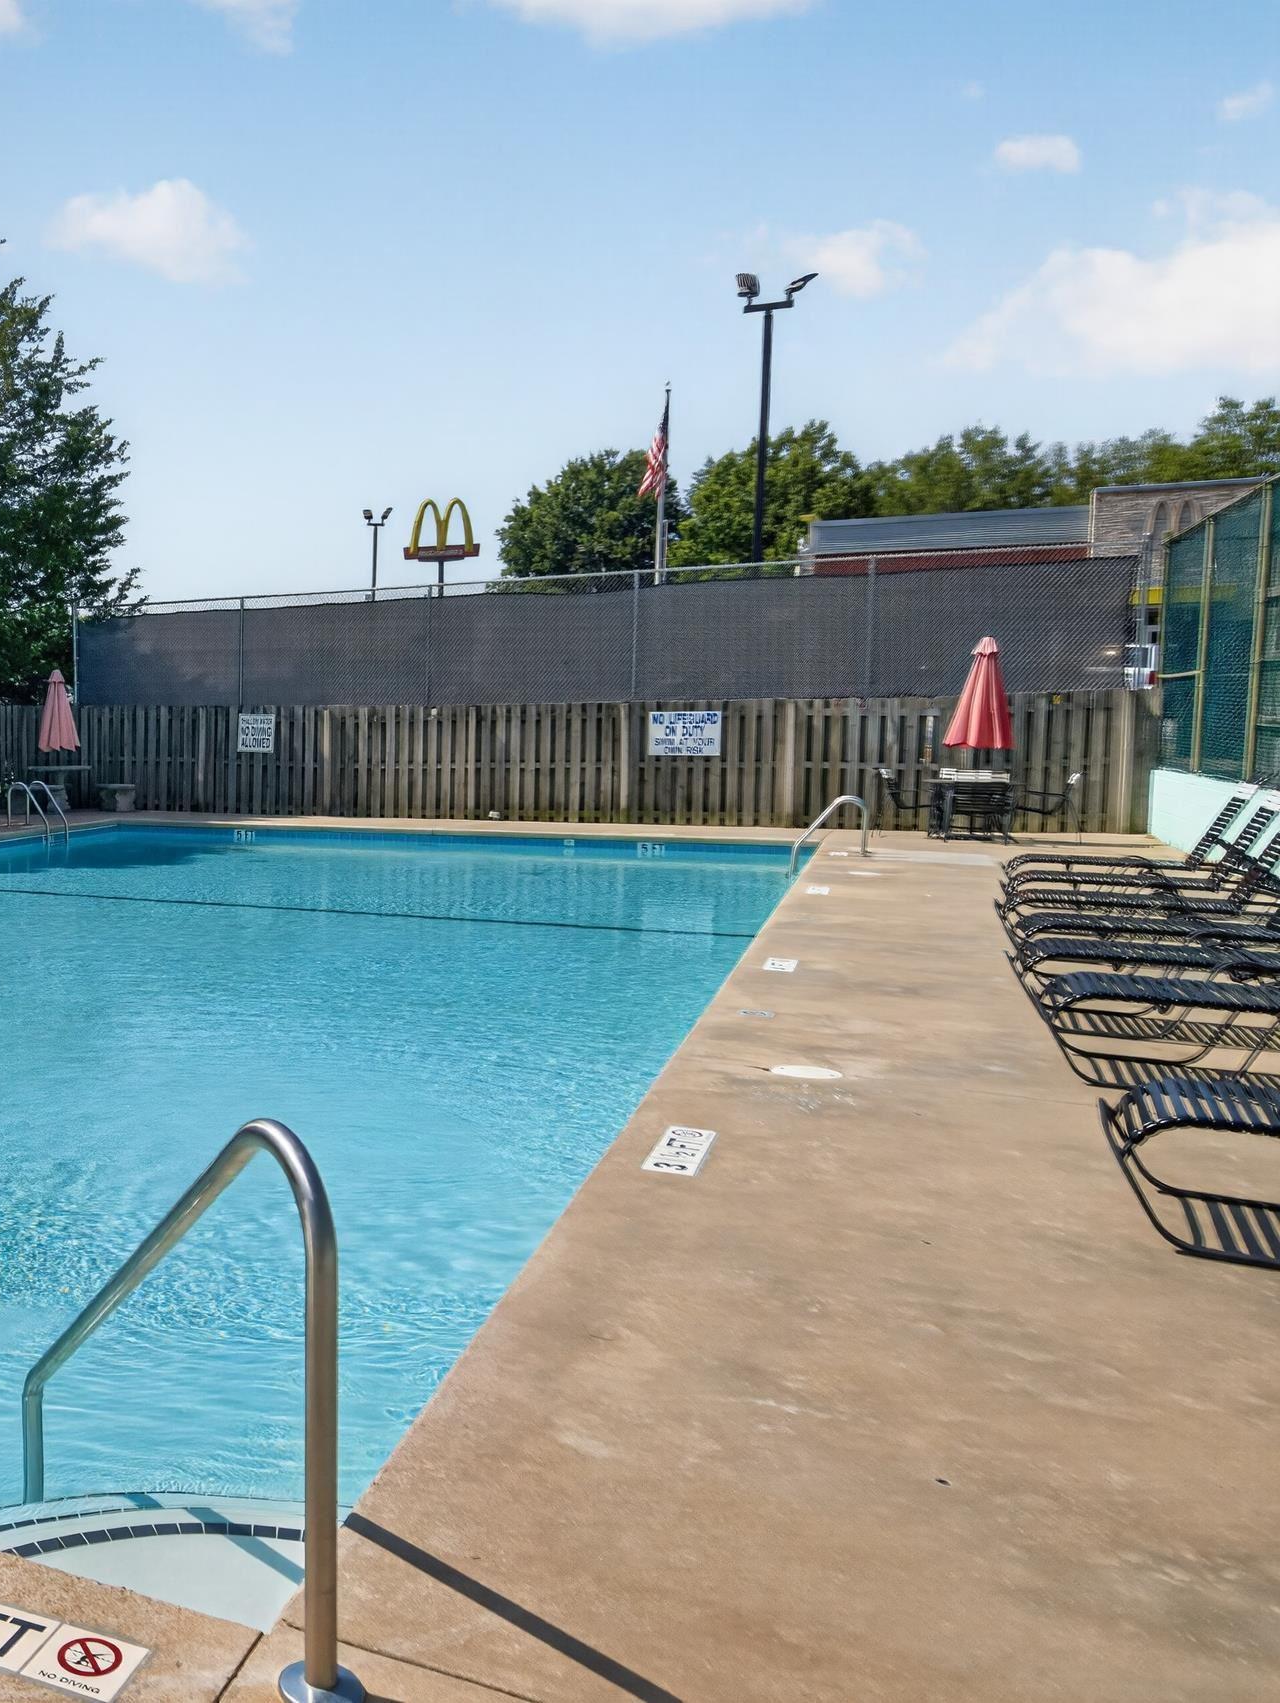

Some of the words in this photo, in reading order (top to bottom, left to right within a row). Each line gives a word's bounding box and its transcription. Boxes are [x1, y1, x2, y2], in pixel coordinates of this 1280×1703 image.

[652, 713, 665, 724] NO
[669, 713, 718, 724] LIFEGUARD
[241, 726, 250, 737] NO
[665, 726, 677, 737] ON
[682, 725, 705, 737] DUTY
[241, 737, 271, 749] ALLOWED
[693, 738, 715, 746] YOUR
[686, 746, 704, 755] RISK
[236, 830, 242, 840] 5
[245, 830, 256, 840] FT
[666, 1138, 704, 1151] FT
[653, 1162, 688, 1171] 3
[38, 1670, 56, 1681] NO
[59, 1676, 101, 1695] DIVING
